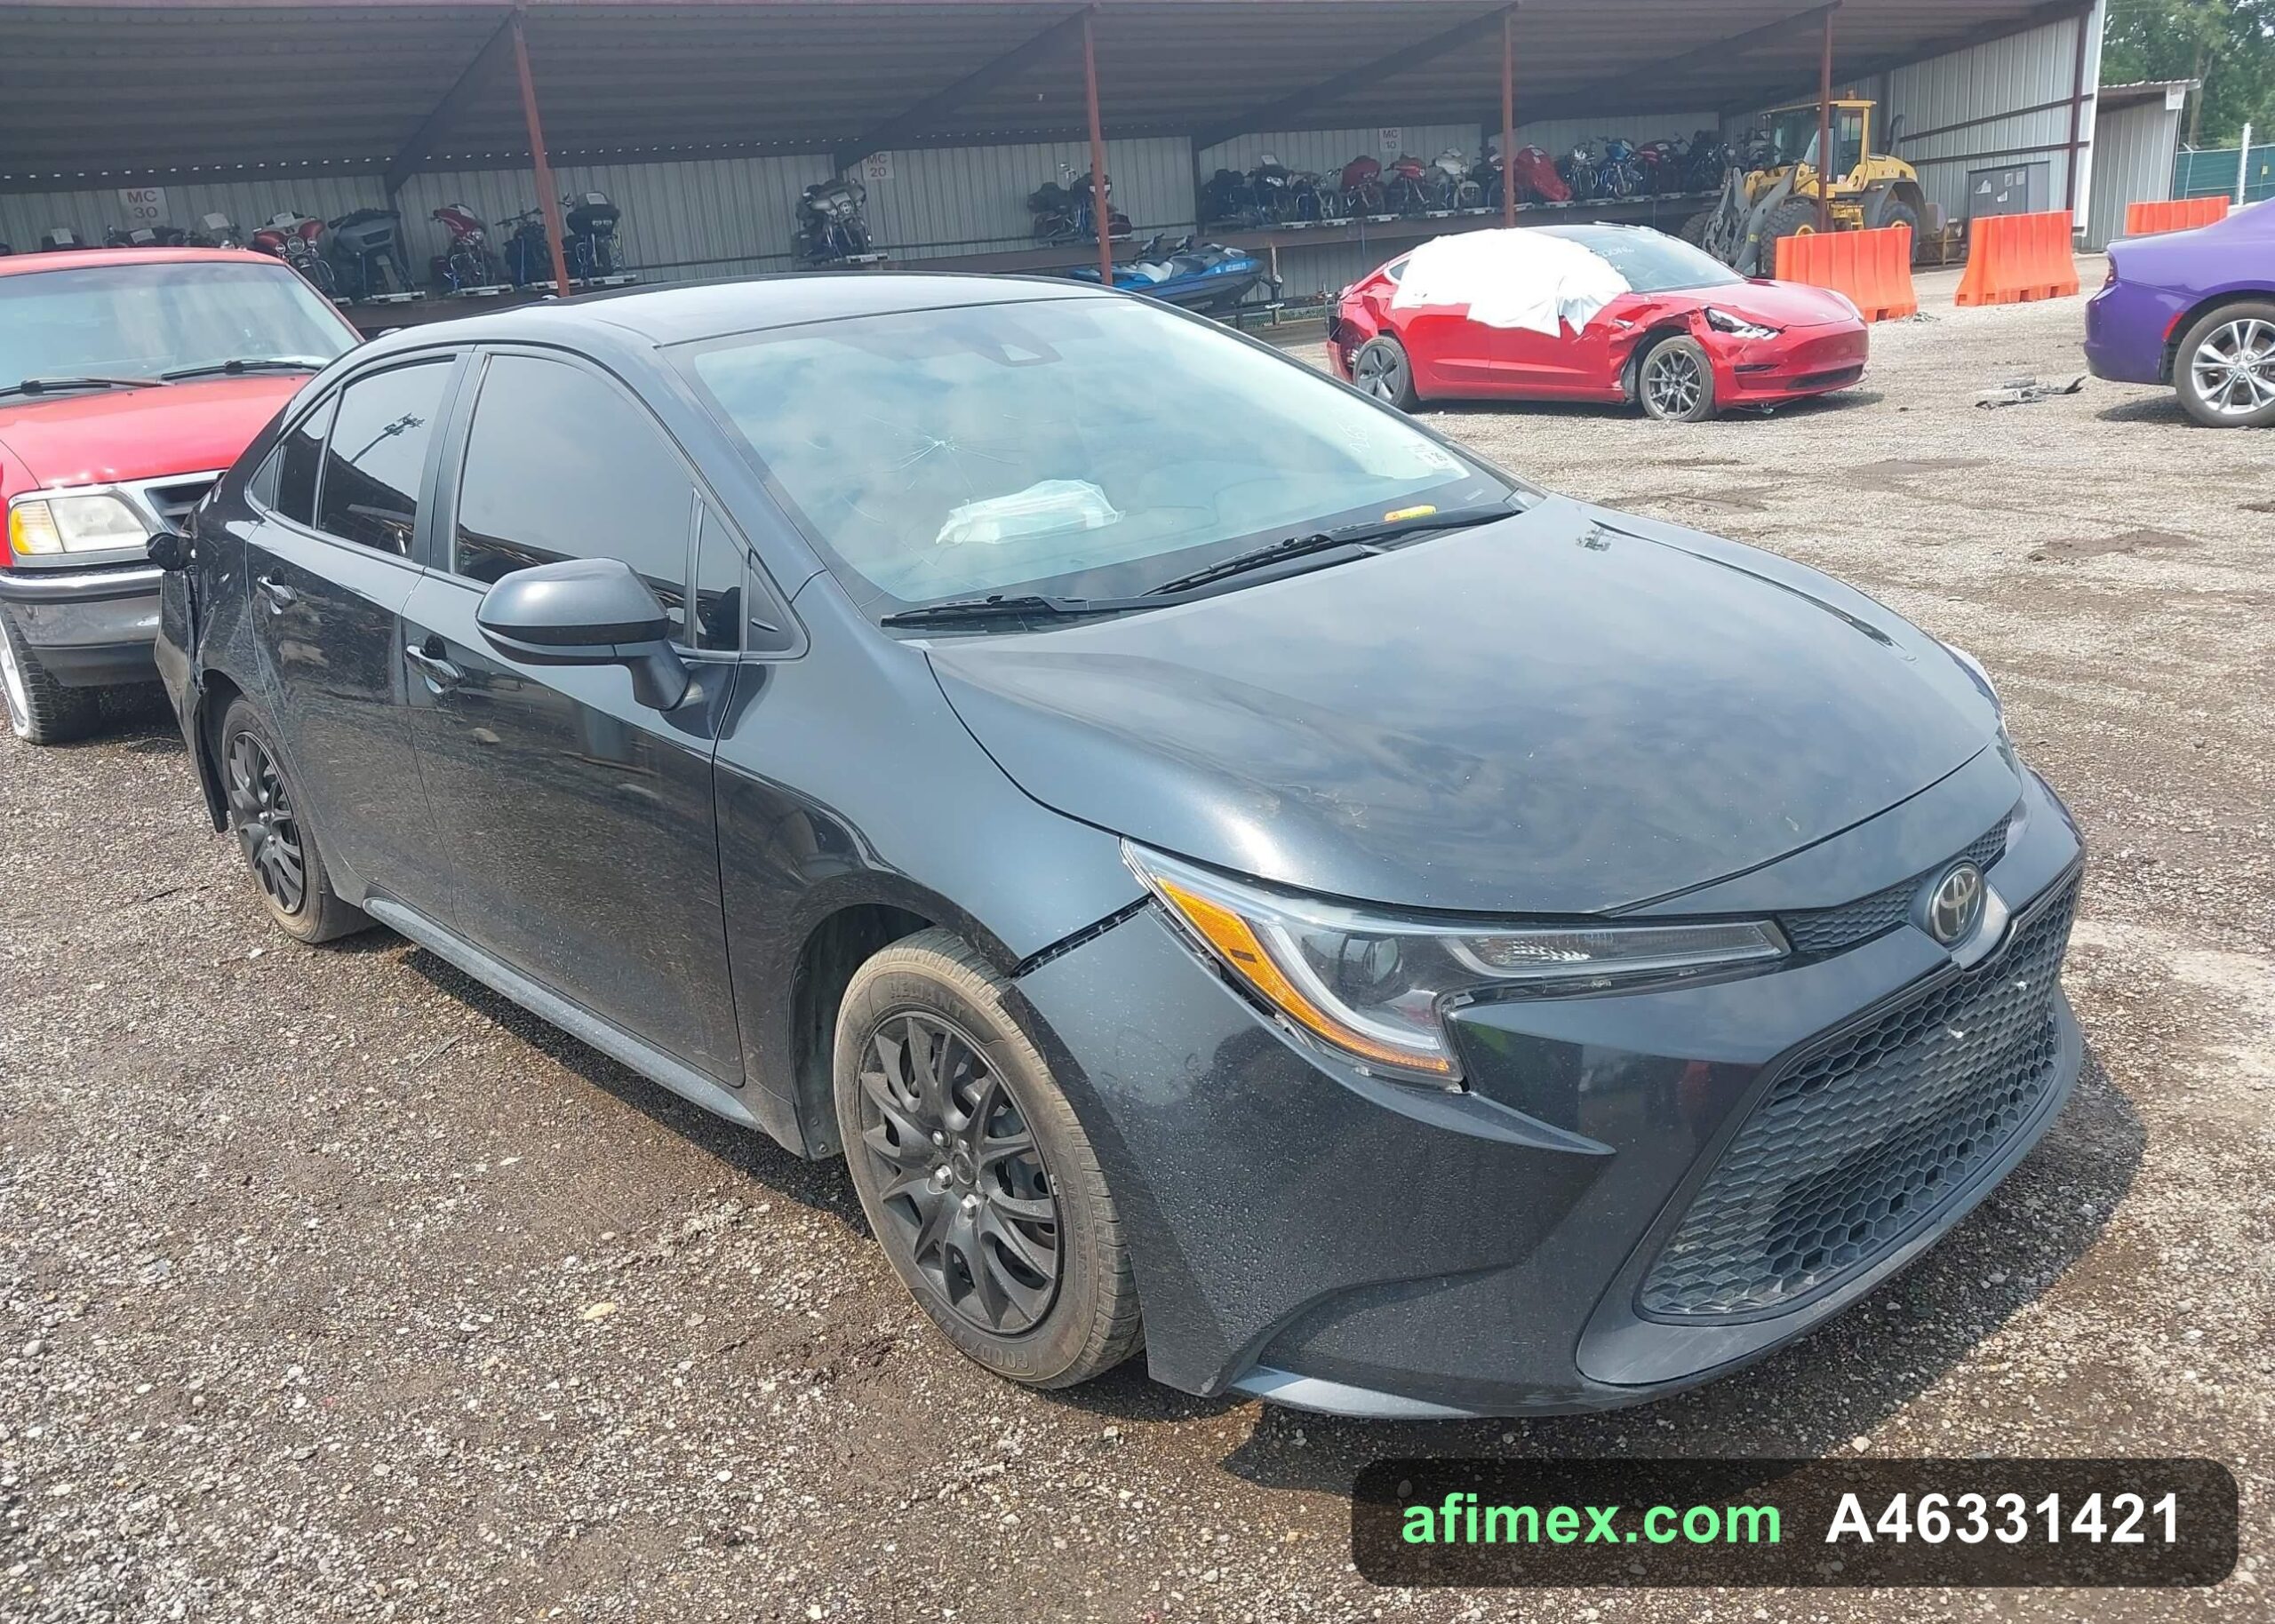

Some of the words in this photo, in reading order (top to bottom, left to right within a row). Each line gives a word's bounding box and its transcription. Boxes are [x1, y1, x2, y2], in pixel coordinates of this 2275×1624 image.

[1386, 140, 1396, 149] 10
[866, 153, 887, 164] MC
[870, 167, 887, 178] 20
[126, 190, 157, 203] MC
[133, 206, 157, 219] 30
